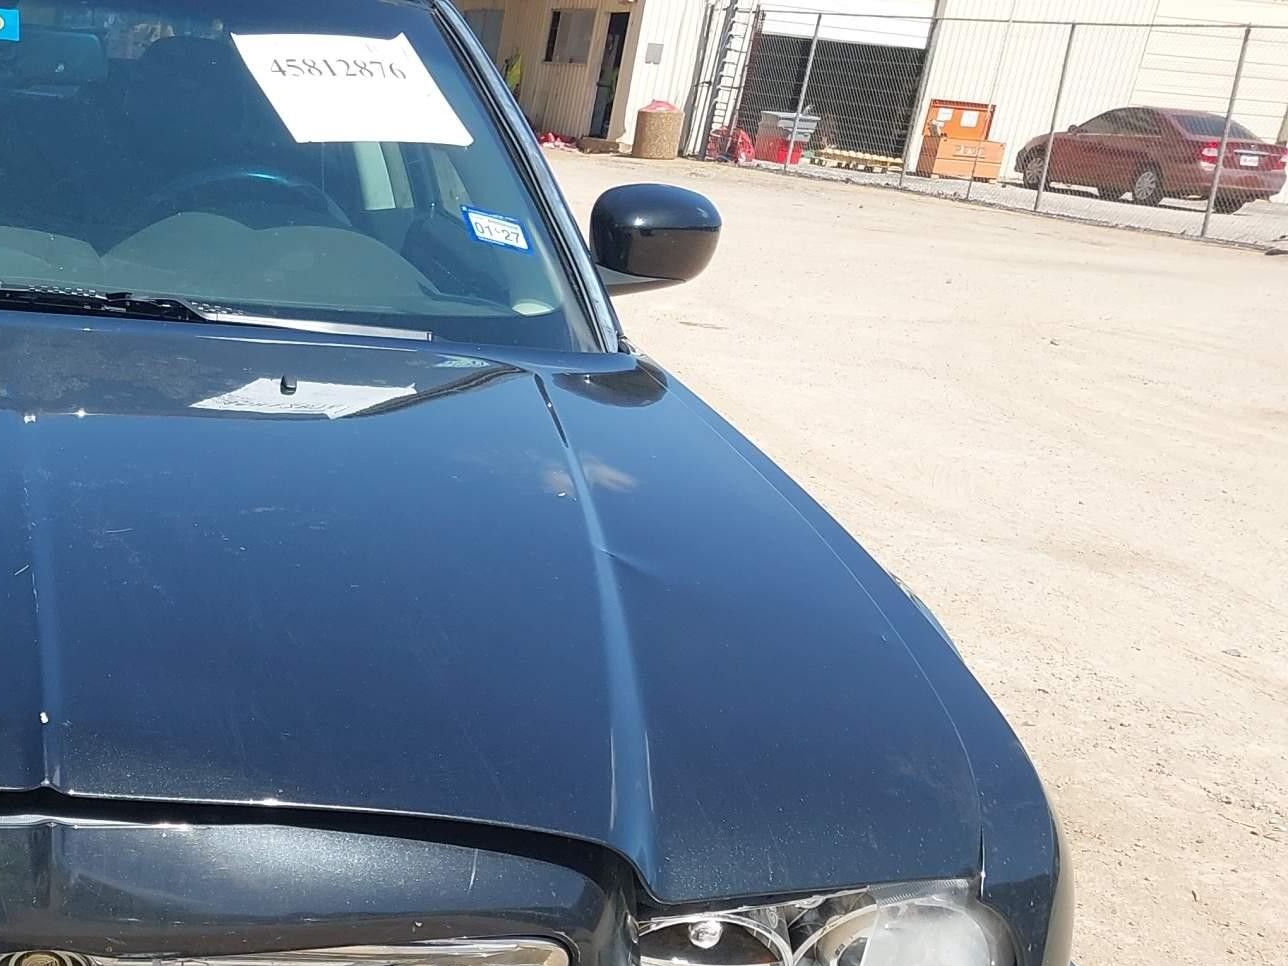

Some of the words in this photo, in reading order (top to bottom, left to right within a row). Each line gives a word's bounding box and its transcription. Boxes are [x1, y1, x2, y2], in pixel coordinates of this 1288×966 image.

[270, 57, 408, 79] 45812876
[475, 222, 493, 236] 01
[501, 229, 520, 243] 27
